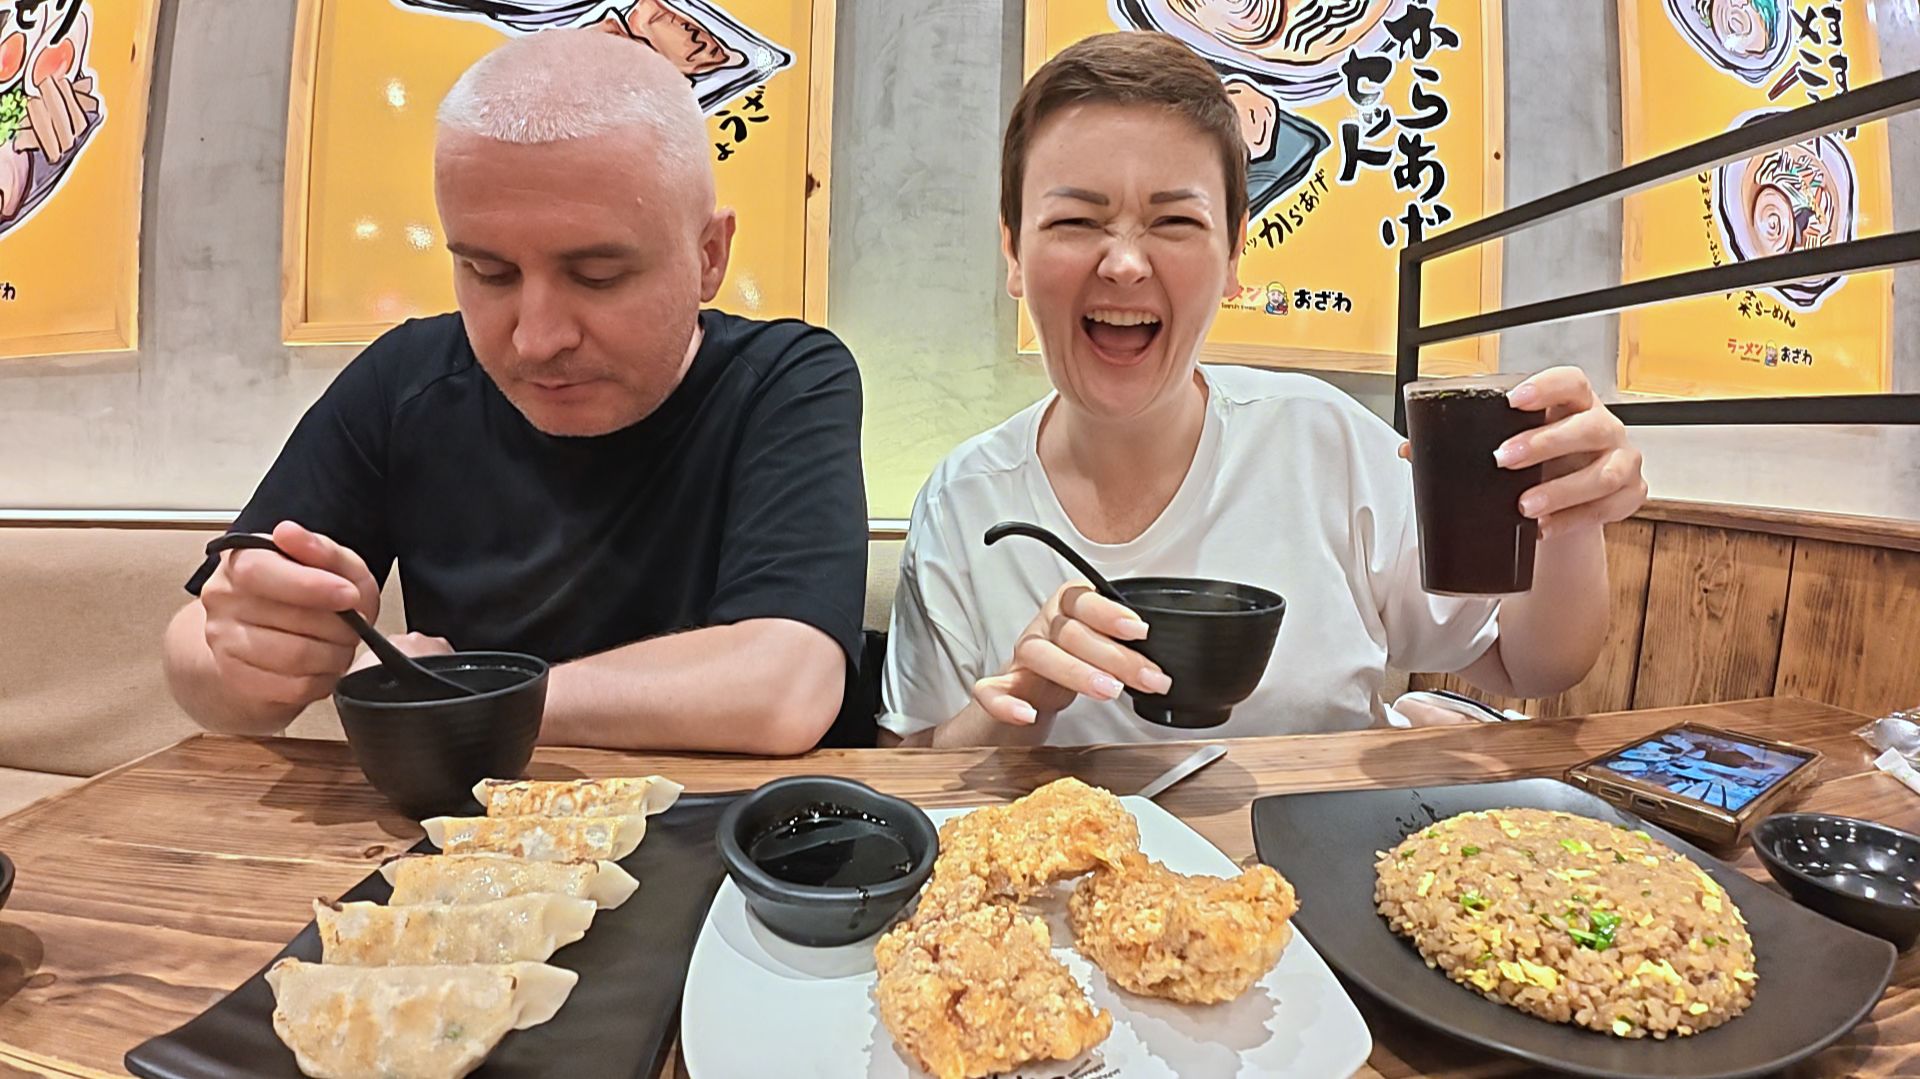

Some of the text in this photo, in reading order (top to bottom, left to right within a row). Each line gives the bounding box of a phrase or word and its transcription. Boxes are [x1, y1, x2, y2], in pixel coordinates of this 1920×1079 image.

[1339, 48, 1393, 182] セット
[1242, 168, 1329, 255] ッからあげ
[1293, 288, 1353, 313] おざわ
[1727, 337, 1814, 366] ラーメン おざわ
